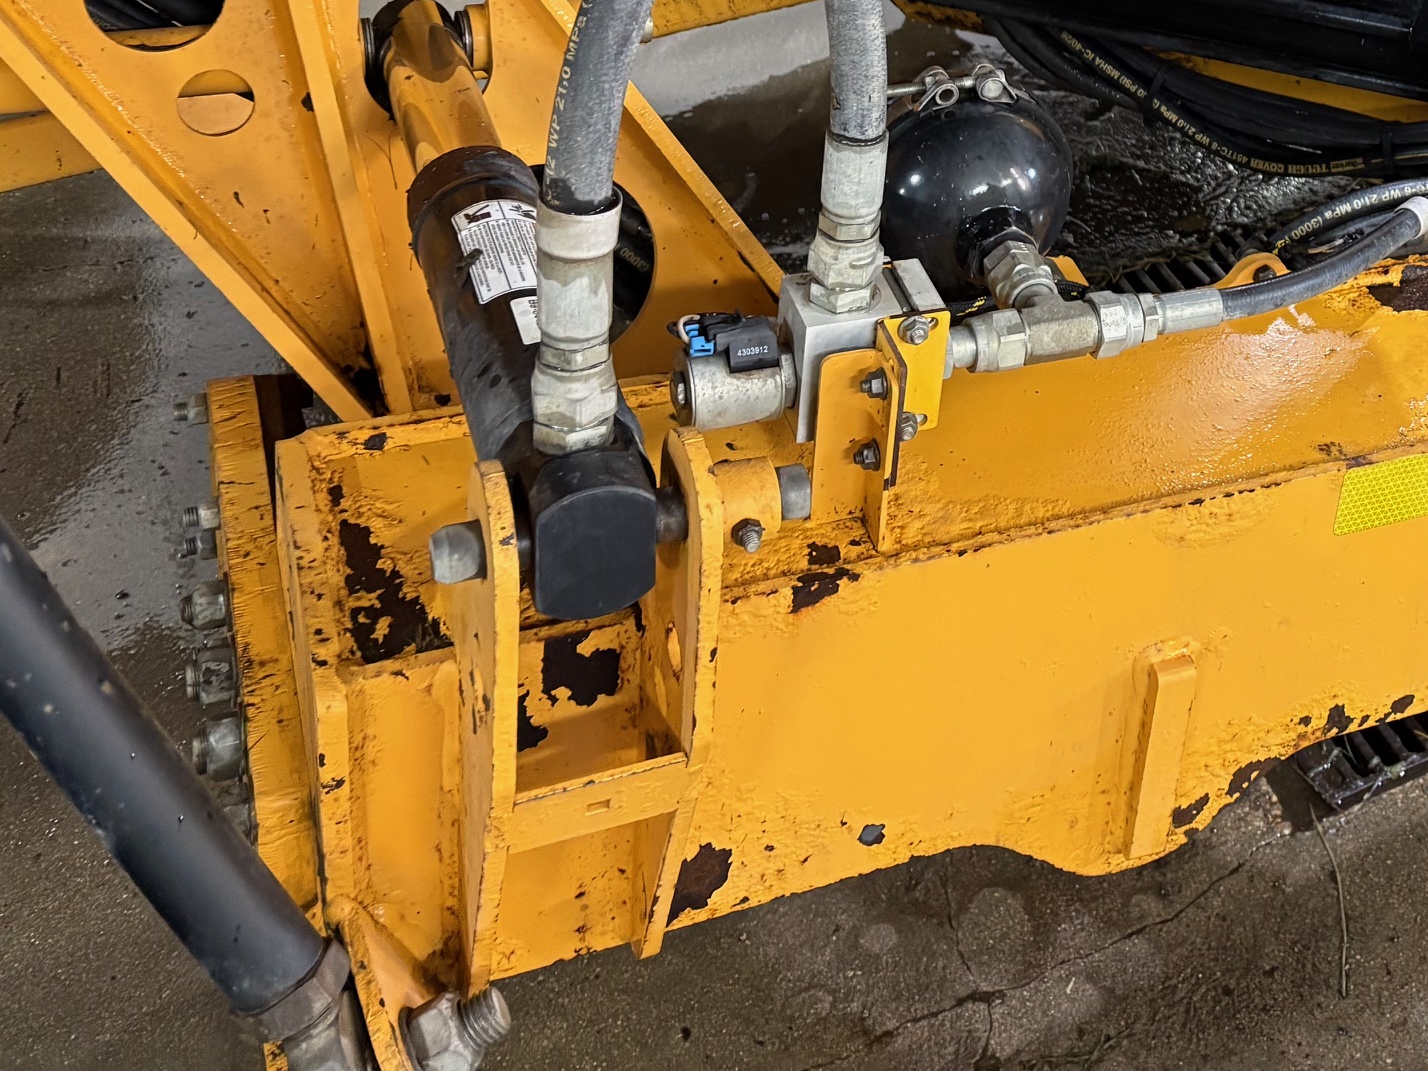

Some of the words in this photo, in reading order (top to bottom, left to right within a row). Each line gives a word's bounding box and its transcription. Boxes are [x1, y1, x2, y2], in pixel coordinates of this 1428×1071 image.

[1094, 56, 1121, 81] MSHA
[548, 114, 561, 149] WP
[565, 15, 588, 61] MPa
[1119, 75, 1139, 93] PSI)
[1160, 105, 1180, 124] MPa
[1195, 132, 1211, 147] WP
[1250, 157, 1285, 174] COVER
[1287, 163, 1329, 175] TOUGH
[1382, 188, 1402, 202] WP
[1324, 203, 1352, 221] MPa
[1291, 215, 1324, 241] (3000
[737, 345, 769, 357] 4303912
